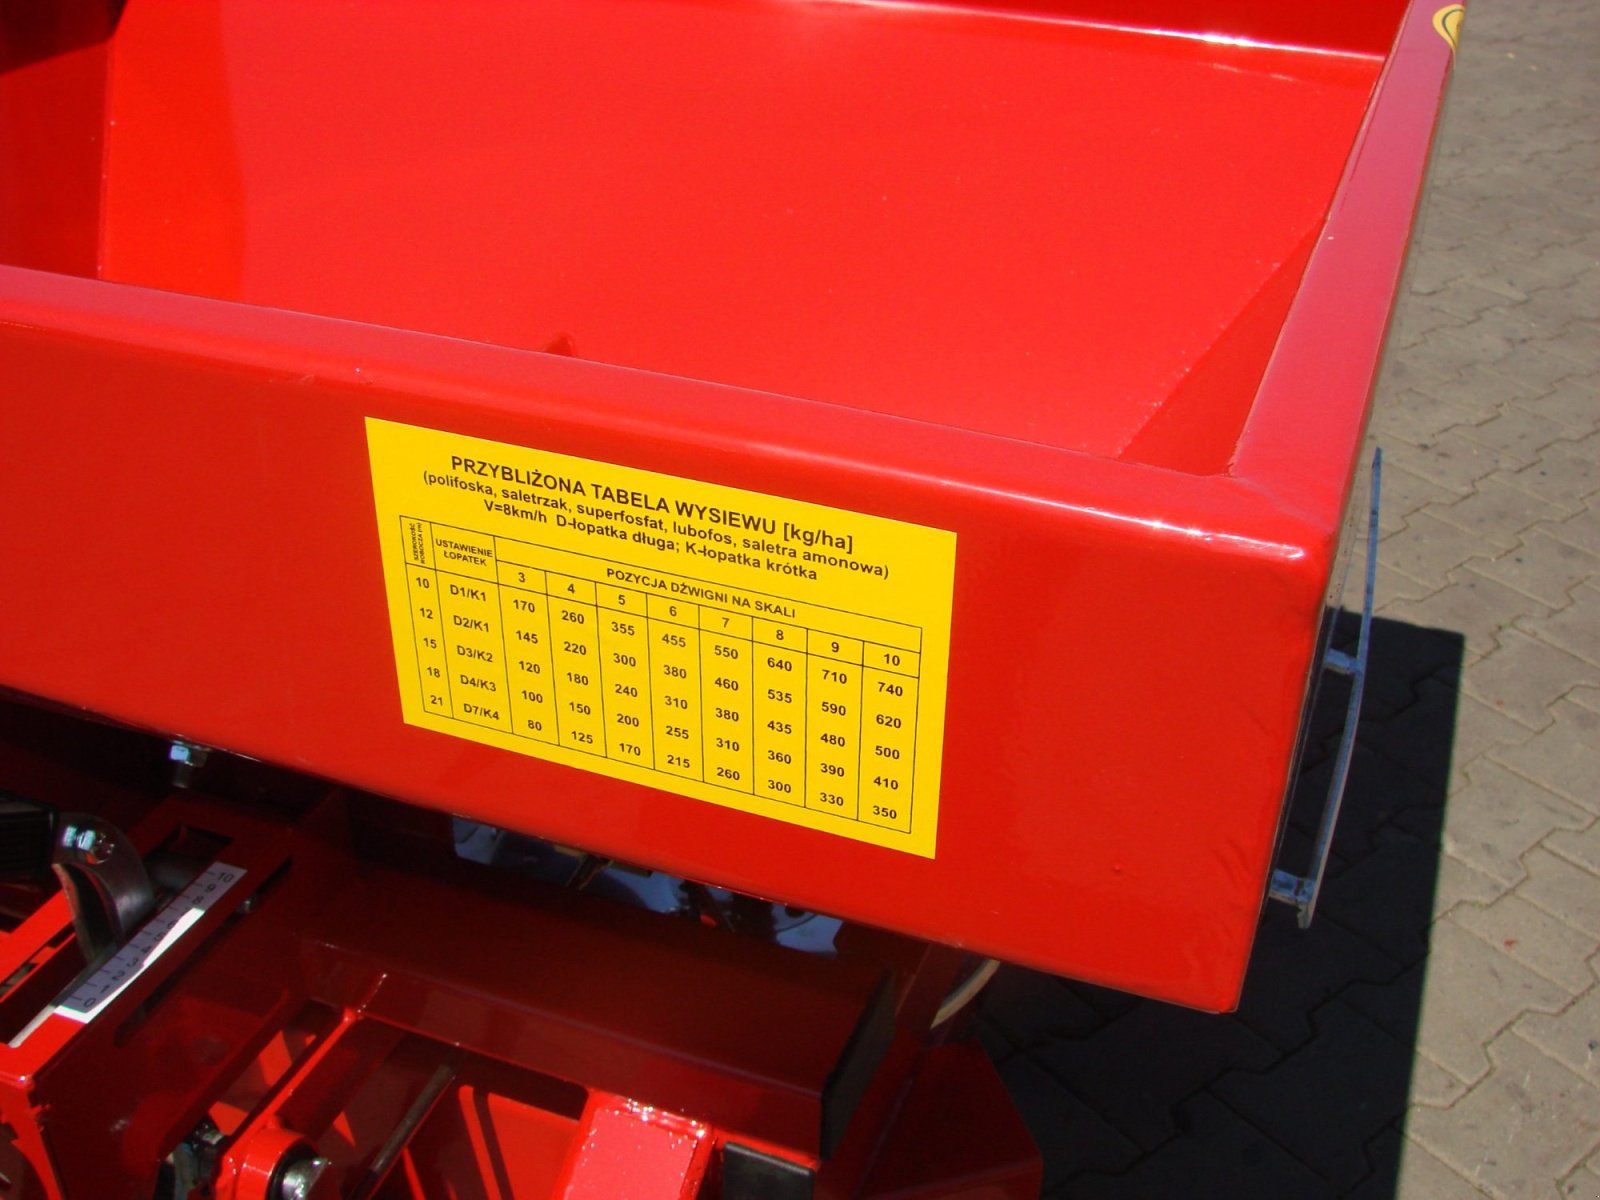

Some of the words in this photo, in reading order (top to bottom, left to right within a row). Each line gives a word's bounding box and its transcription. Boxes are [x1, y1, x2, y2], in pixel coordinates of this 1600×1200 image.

[423, 470, 497, 498] (polifoska,
[501, 489, 572, 513] saletrzak,
[576, 504, 668, 533] superfosfat,
[673, 521, 737, 548] lubofos,
[742, 538, 797, 558] saletra
[802, 551, 889, 580] amonowa)
[451, 456, 586, 497] PRZYBLIŻONA
[590, 483, 670, 514] TABELA
[675, 500, 776, 535] WYSIEWU
[784, 522, 853, 555] [kg/ha]
[435, 538, 493, 558] USTAWIENIE
[444, 550, 486, 566] ŁOPATEK
[484, 499, 547, 523] V=8km/h
[556, 514, 628, 540] D-łopatka
[632, 531, 679, 553] długa;
[686, 541, 761, 568] K-łopatka
[766, 558, 817, 580] krótka
[518, 572, 526, 583] 3
[567, 583, 575, 594] 4
[618, 594, 626, 605] 5
[669, 606, 677, 617] 6
[722, 617, 730, 628] 7
[776, 629, 784, 641] 8
[831, 641, 840, 653] 9
[884, 653, 900, 666] 10
[607, 568, 668, 590] POZYCJA
[671, 582, 728, 603] DŹWIGNI
[732, 595, 751, 608] NA
[755, 600, 795, 618] SKALI
[416, 577, 430, 589] 10
[450, 584, 486, 602] D1/K1
[513, 599, 535, 613] 170
[561, 610, 584, 624] 260
[611, 621, 635, 636] 355
[662, 633, 686, 648] 455
[714, 645, 738, 660] 550
[767, 657, 792, 672] 640
[822, 669, 847, 684] 710
[878, 681, 903, 697] 740
[420, 607, 433, 619] 12
[453, 615, 489, 632] D2/K1
[516, 630, 538, 644] 145
[564, 641, 587, 656] 220
[613, 653, 636, 667] 300
[664, 664, 687, 679] 380
[714, 677, 739, 691] 460
[768, 689, 792, 704] 535
[821, 701, 846, 716] 590
[876, 714, 902, 729] 620
[423, 637, 437, 649] 15
[457, 645, 493, 663] D3/K2
[519, 661, 540, 674] 120
[567, 672, 589, 686] 180
[615, 684, 638, 698] 240
[665, 695, 688, 710] 310
[716, 707, 739, 722] 380
[767, 720, 792, 734] 435
[820, 733, 845, 747] 480
[875, 745, 900, 760] 500
[427, 667, 440, 678] 18
[460, 674, 496, 692] D4/K3
[522, 690, 543, 703] 100
[569, 702, 591, 715] 150
[617, 713, 639, 727] 200
[666, 725, 689, 739] 255
[716, 737, 740, 752] 310
[768, 750, 792, 764] 360
[820, 763, 845, 777] 390
[873, 776, 899, 790] 410
[430, 695, 443, 706] 21
[463, 703, 499, 720] D7/K4
[528, 720, 542, 731] 80
[571, 731, 593, 744] 125
[619, 743, 641, 756] 170
[667, 754, 690, 768] 215
[717, 767, 740, 781] 260
[768, 779, 791, 794] 300
[820, 792, 844, 806] 330
[873, 805, 897, 819] 350
[204, 883, 216, 893] 9
[217, 872, 234, 883] 10
[100, 984, 110, 993] 1
[111, 970, 126, 981] 2
[126, 957, 139, 968] 3
[84, 997, 97, 1008] 0
